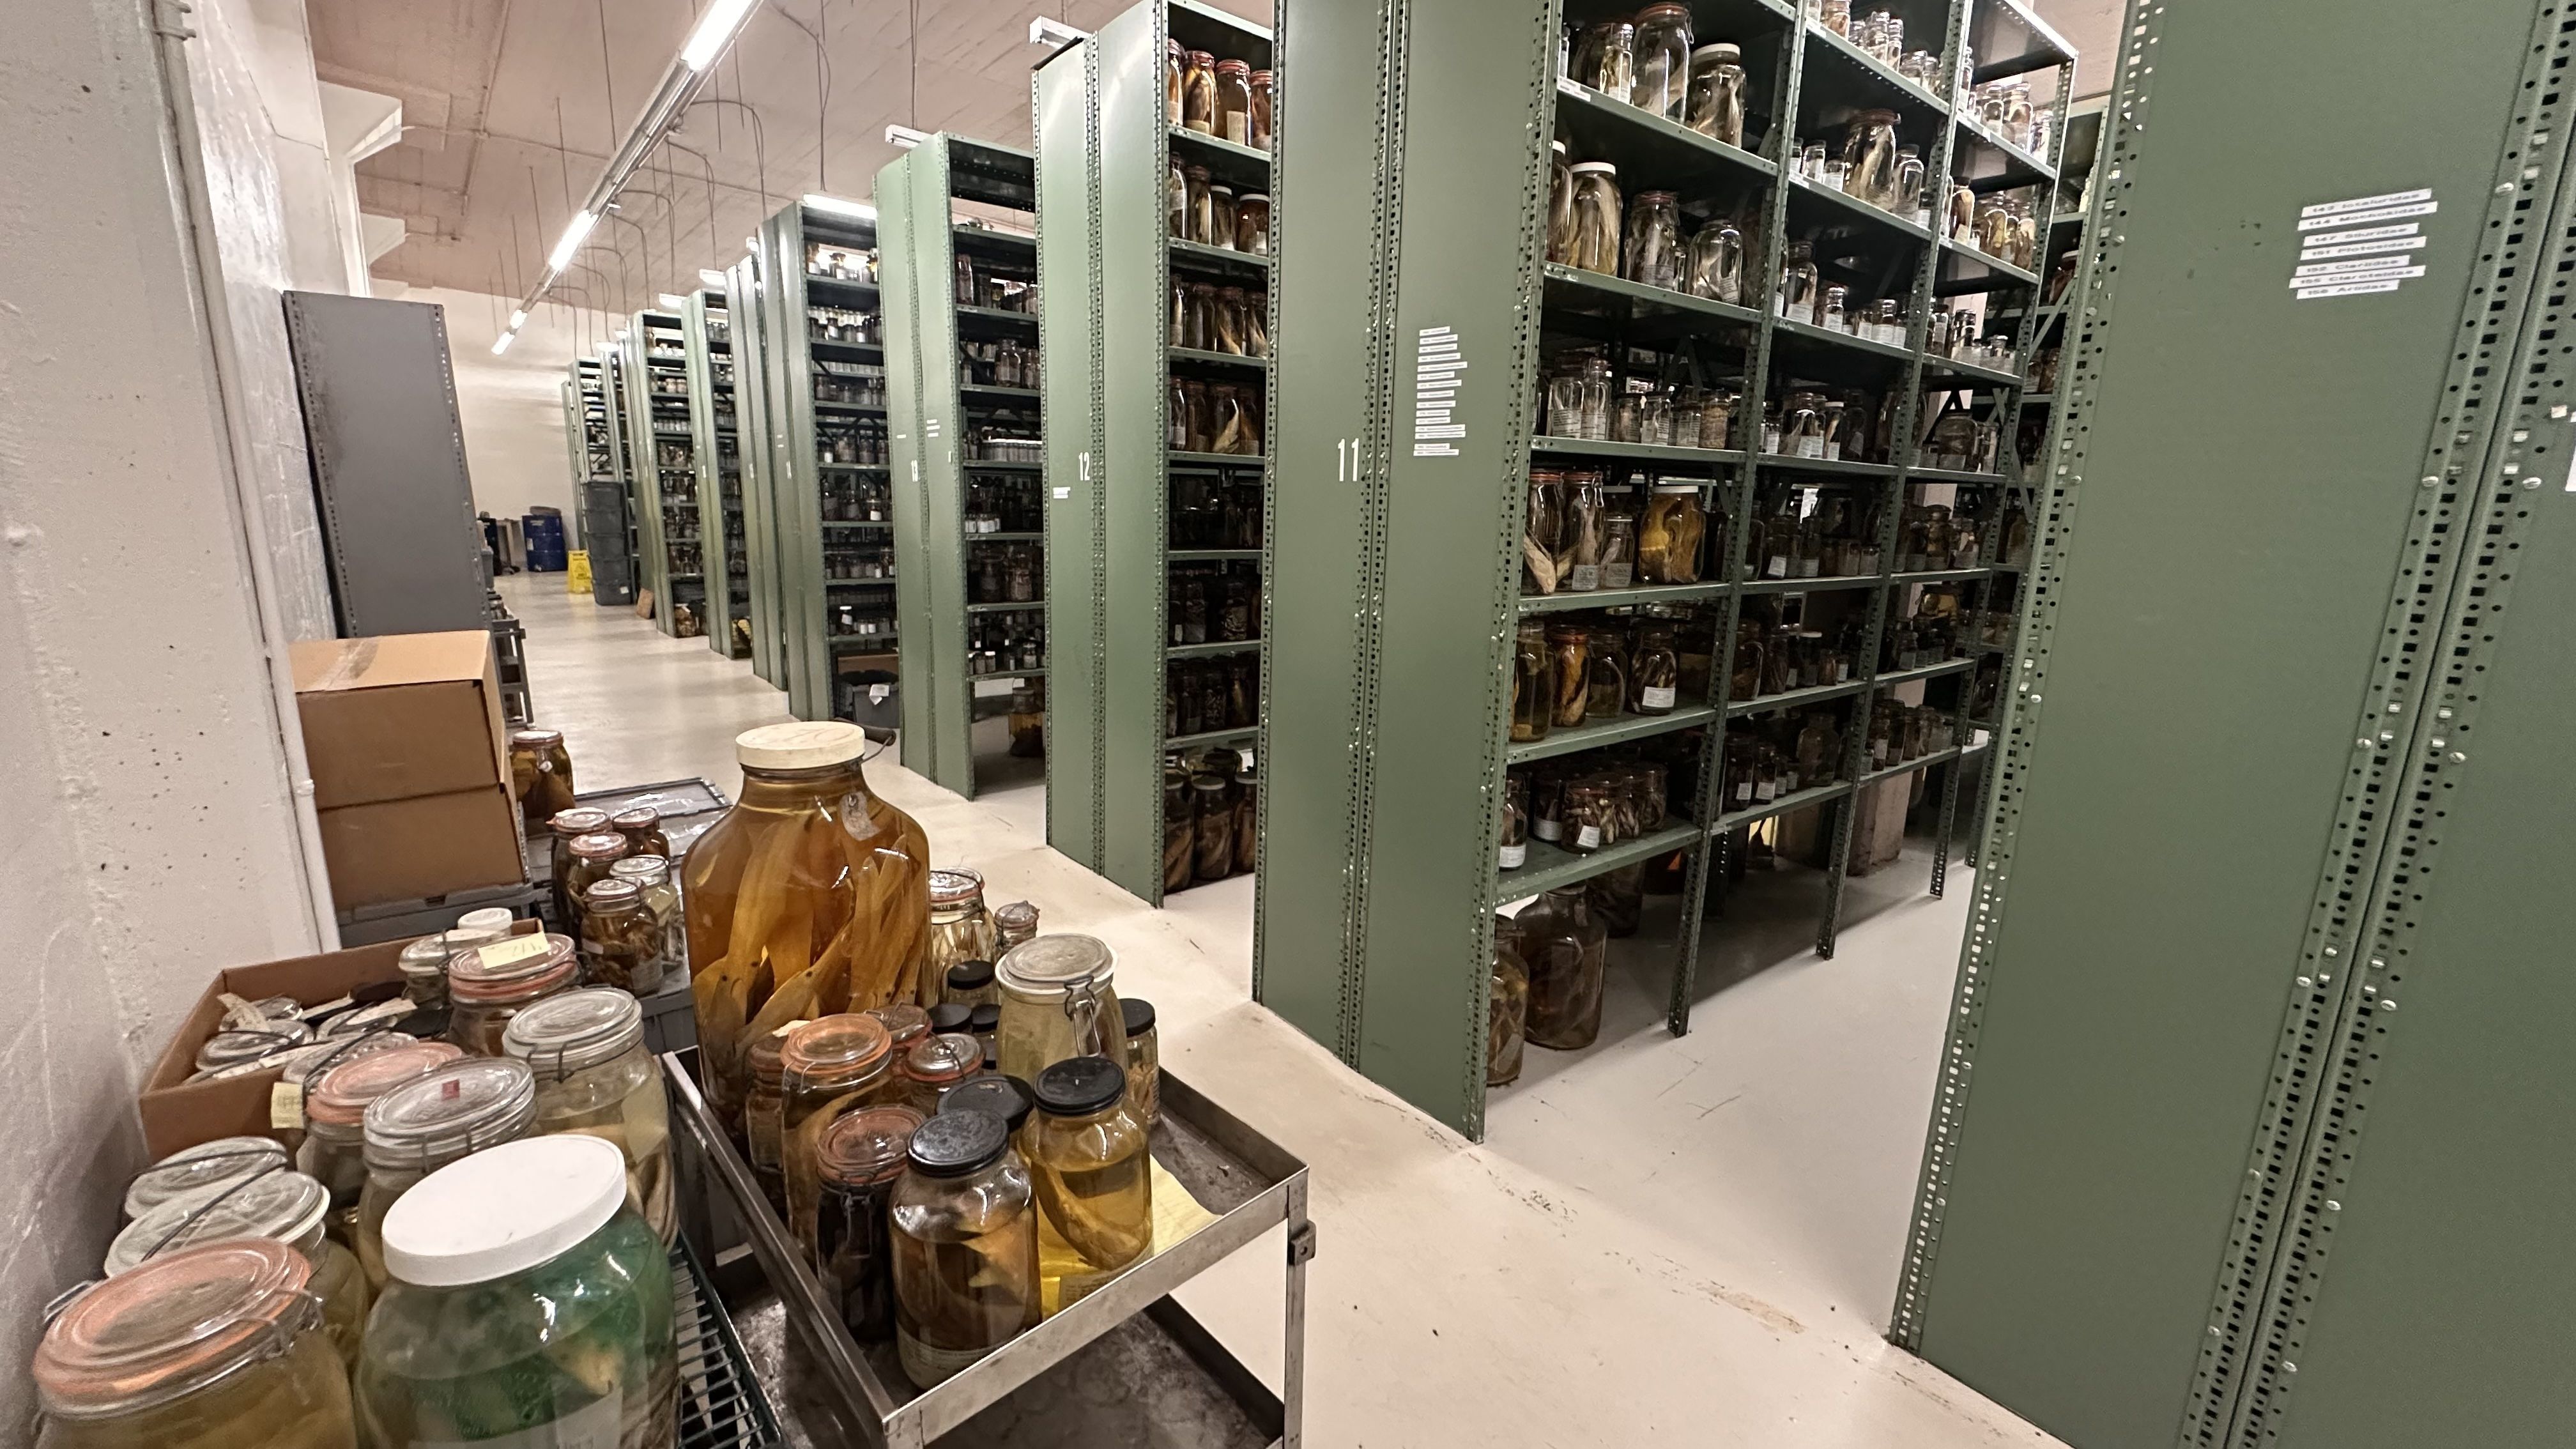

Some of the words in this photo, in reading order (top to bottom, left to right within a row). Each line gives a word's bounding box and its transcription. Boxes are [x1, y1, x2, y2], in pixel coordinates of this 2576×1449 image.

[2339, 206, 2426, 222] Mochokidae
[2345, 227, 2407, 239] Siluridae
[2337, 241, 2414, 253] Plotosidae
[2336, 283, 2389, 293] Ariidae
[1078, 452, 1090, 481] 12
[1337, 438, 1360, 482] 11
